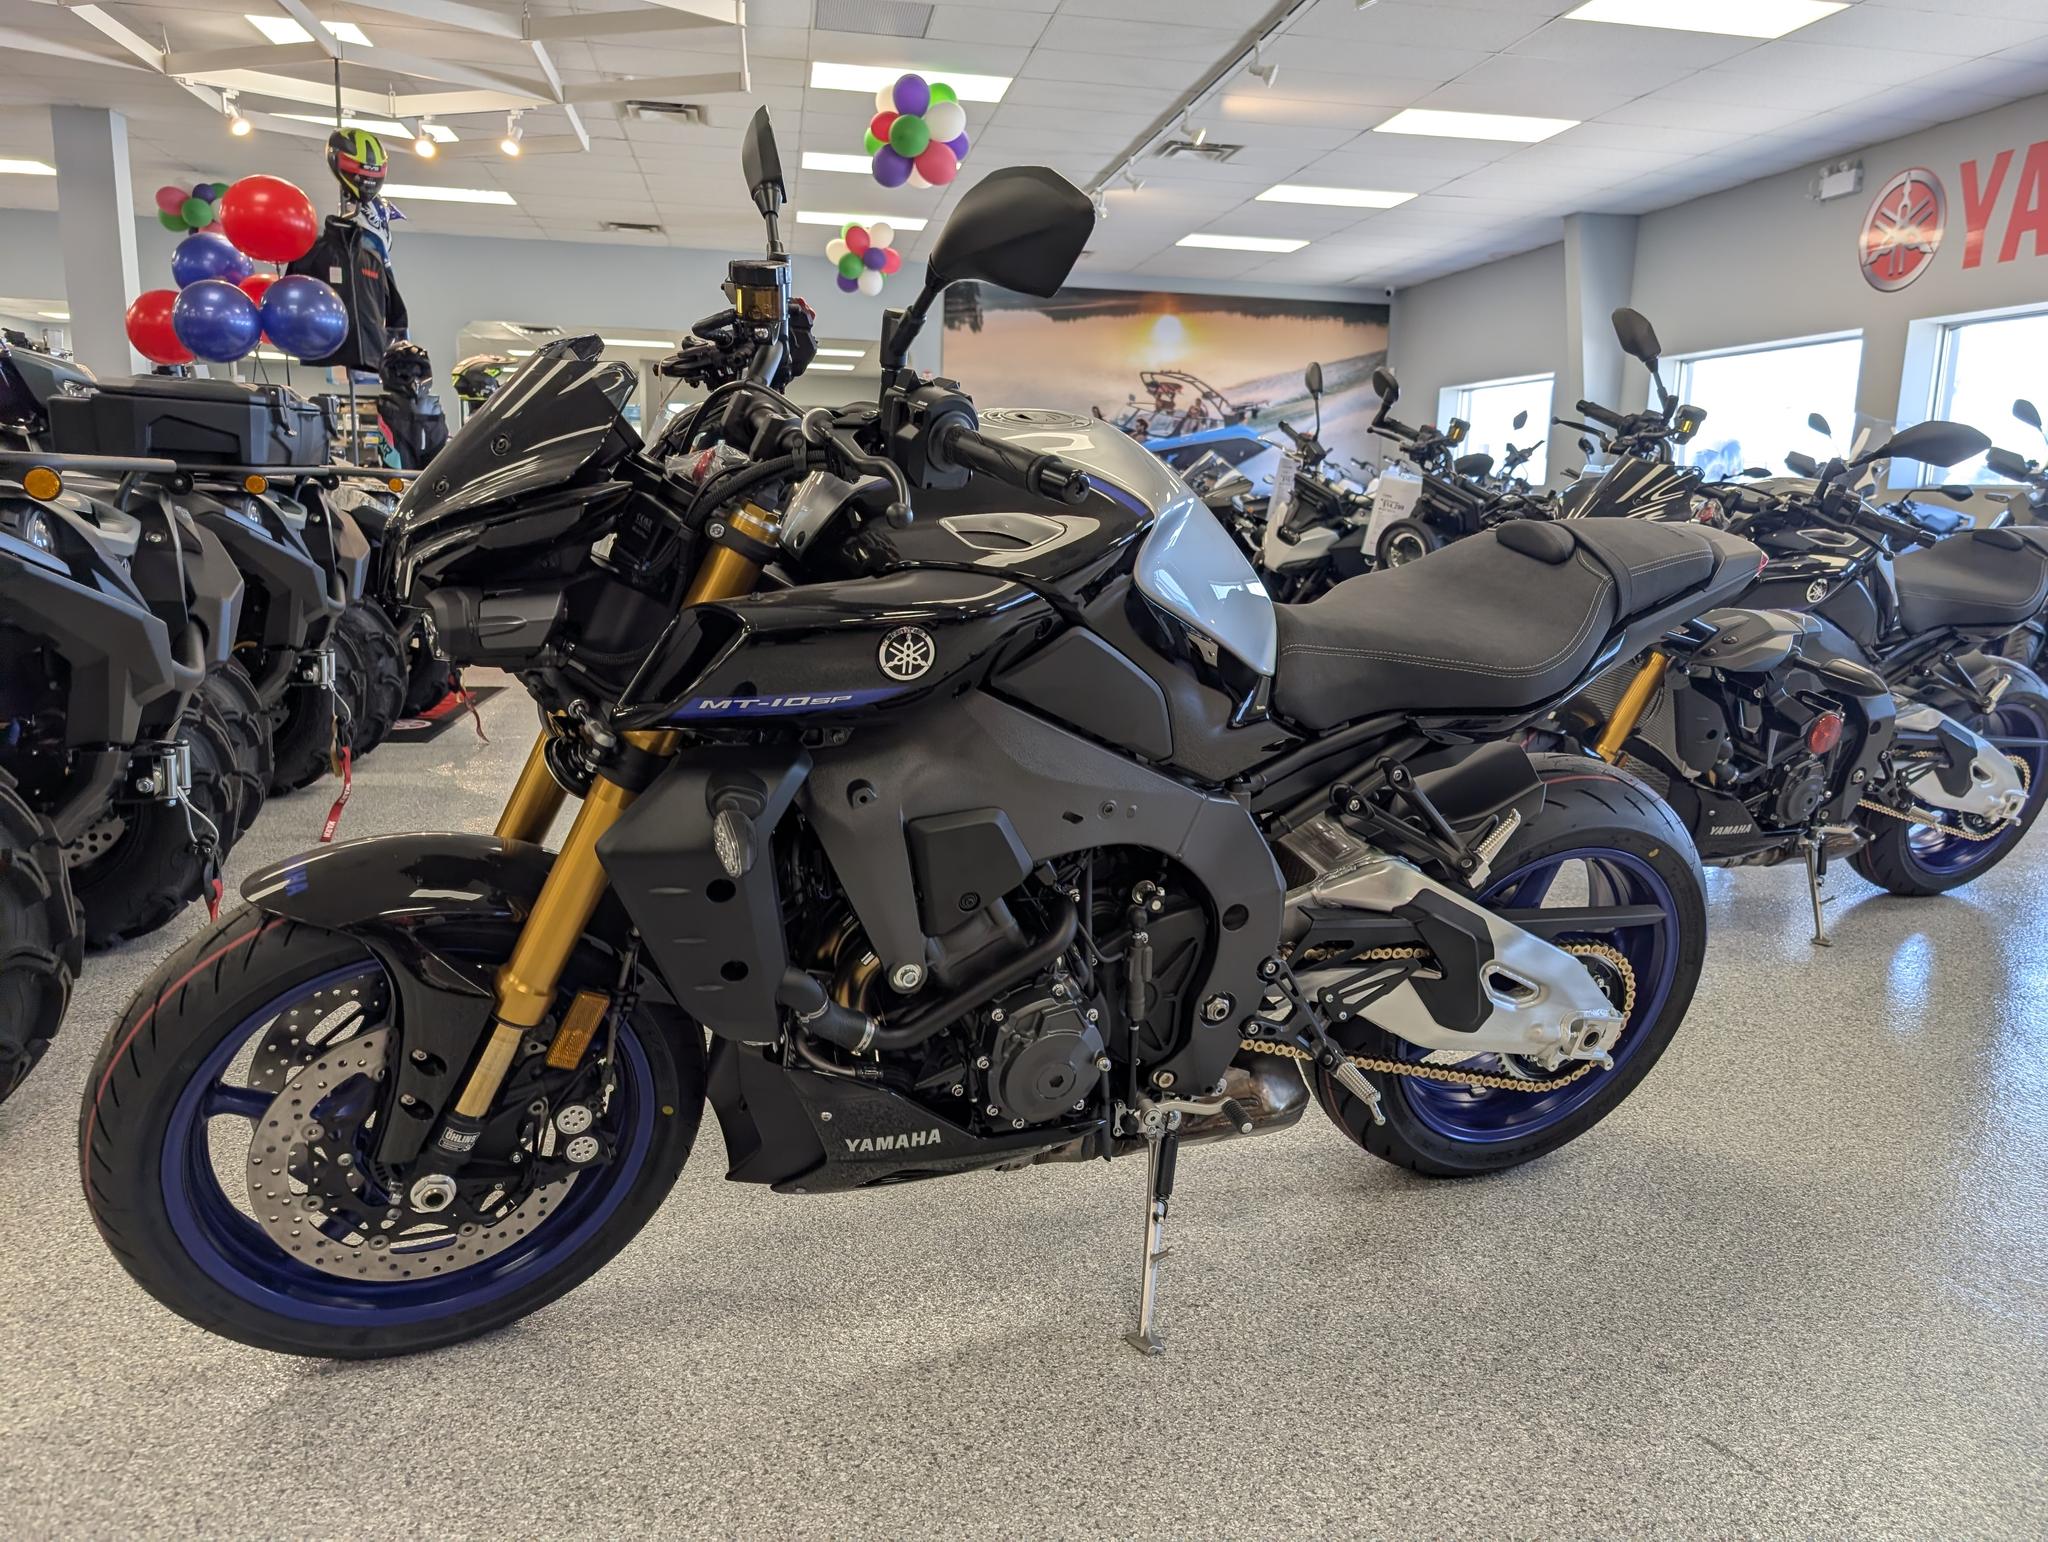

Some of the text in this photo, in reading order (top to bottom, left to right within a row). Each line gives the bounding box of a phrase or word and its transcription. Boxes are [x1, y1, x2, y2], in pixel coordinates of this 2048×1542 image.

[1960, 140, 2048, 270] YA
[1710, 823, 1752, 836] YAMAHA
[845, 1128, 941, 1152] YAMAHA
